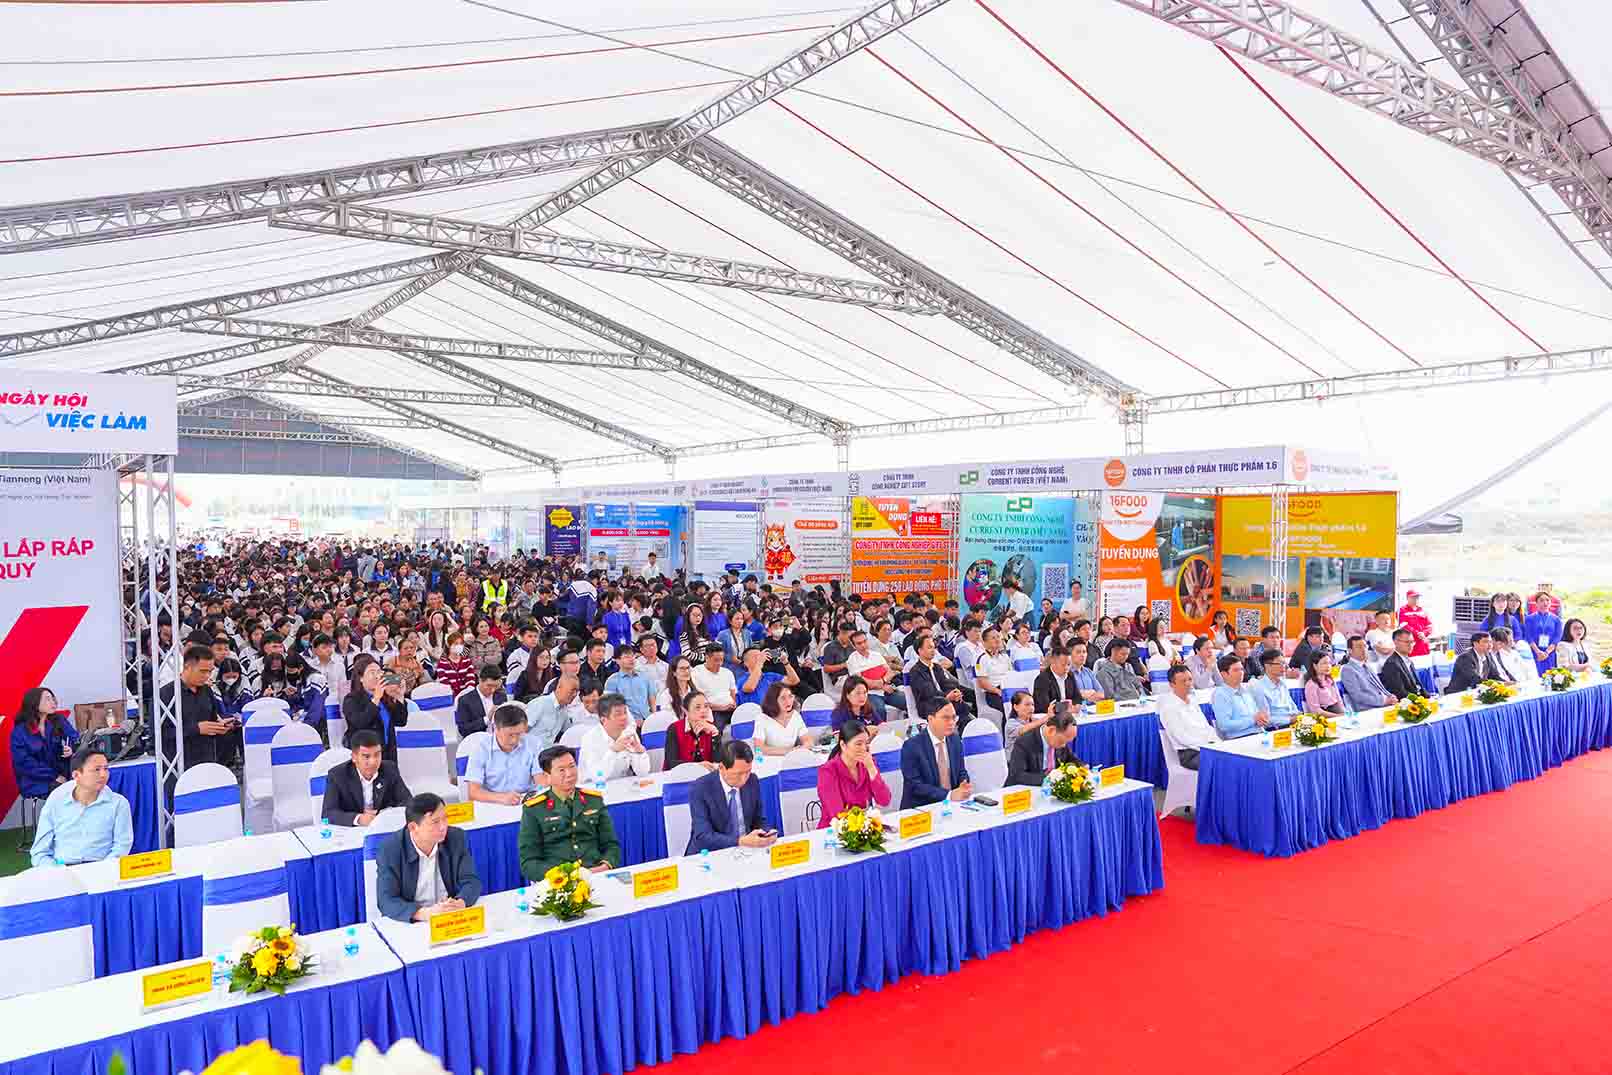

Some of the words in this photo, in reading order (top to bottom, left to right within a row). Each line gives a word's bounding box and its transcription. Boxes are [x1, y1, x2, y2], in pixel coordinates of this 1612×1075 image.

[53, 393, 88, 409] HỘI
[46, 411, 96, 432] VIỆC
[100, 412, 147, 430] LÀM
[1153, 465, 1162, 475] TY
[1163, 464, 1183, 475] TNHH
[1265, 460, 1278, 470] 1.6
[67, 474, 91, 485] Nam)
[1110, 495, 1148, 507] 16FOOD
[4, 538, 45, 558] LẮP
[51, 537, 95, 556] RÁP
[1101, 544, 1132, 559] TUYỂN
[1132, 547, 1159, 561] DỤNG
